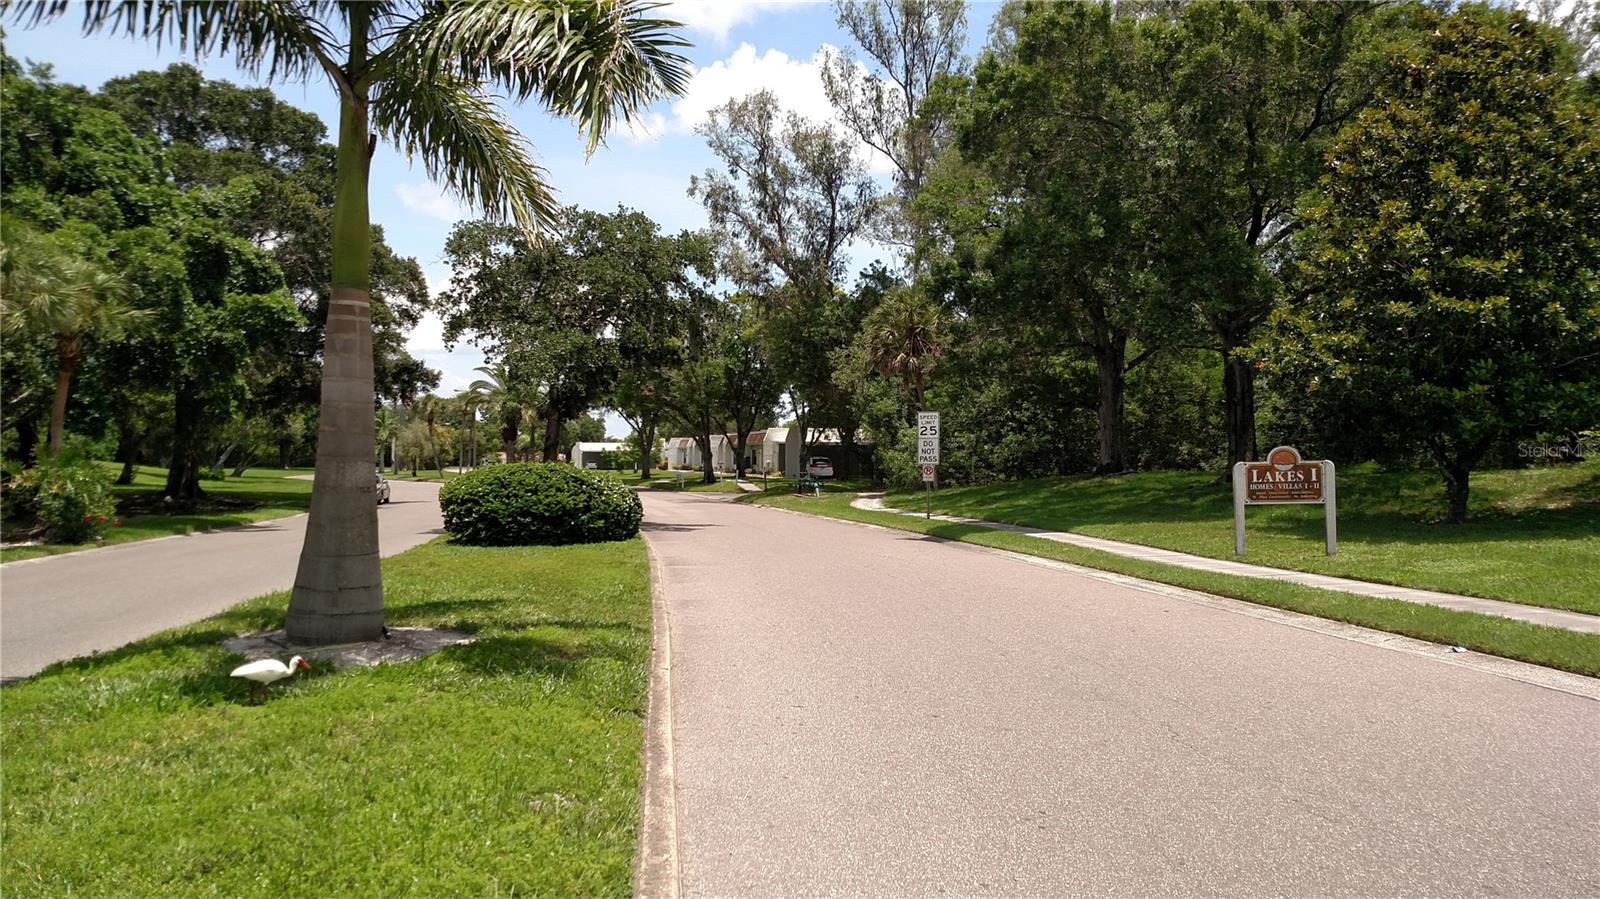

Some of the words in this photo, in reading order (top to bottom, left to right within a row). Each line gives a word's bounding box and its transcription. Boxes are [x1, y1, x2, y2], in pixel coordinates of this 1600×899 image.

[920, 426, 937, 436] 25
[1251, 469, 1304, 483] LAKES
[1310, 468, 1318, 482] I
